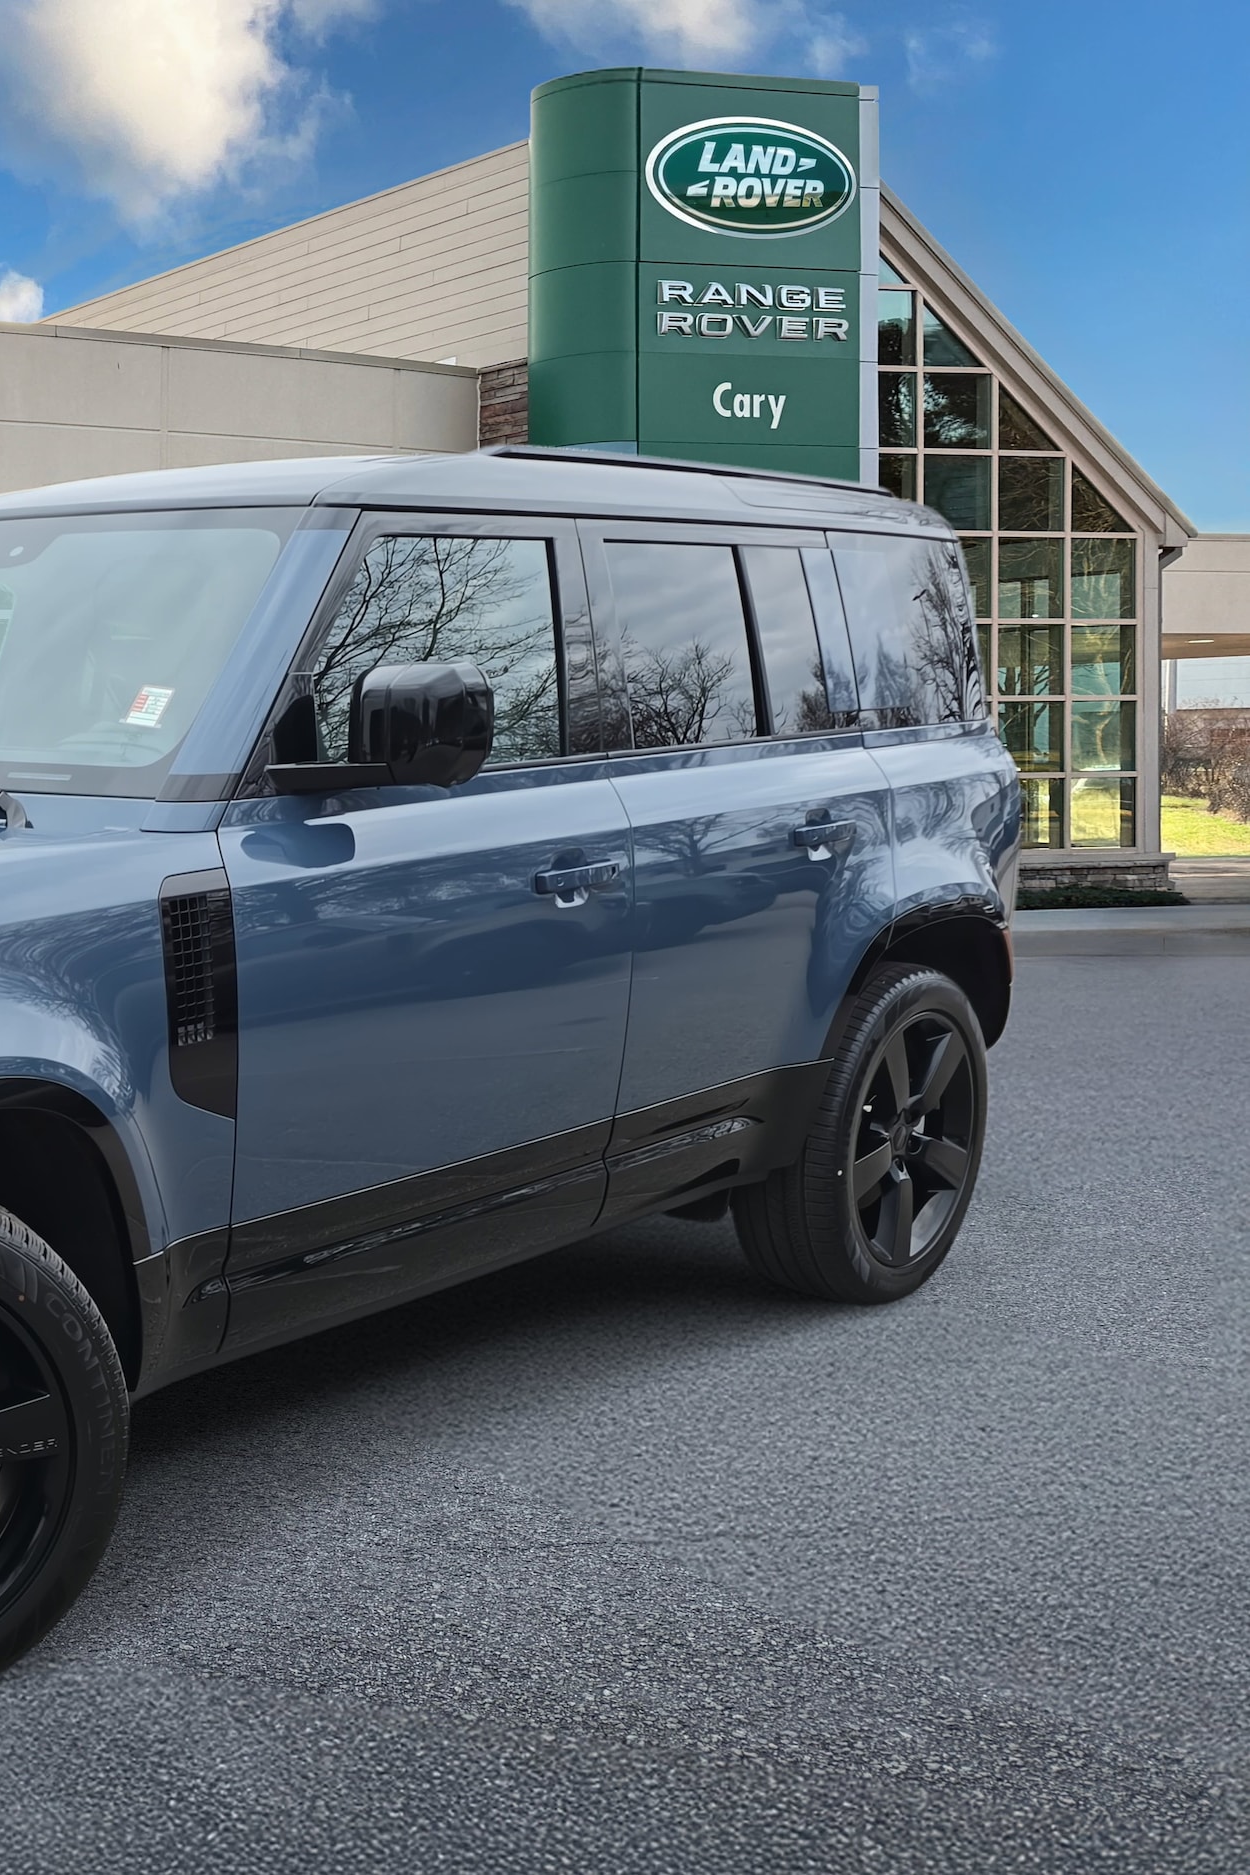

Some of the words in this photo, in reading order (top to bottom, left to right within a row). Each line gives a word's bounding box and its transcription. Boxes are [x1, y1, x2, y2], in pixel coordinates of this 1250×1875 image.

[697, 141, 797, 176] LAND
[710, 176, 825, 208] ROVER
[657, 280, 847, 312] RANGE
[657, 311, 850, 342] ROVER
[712, 382, 787, 429] Cary
